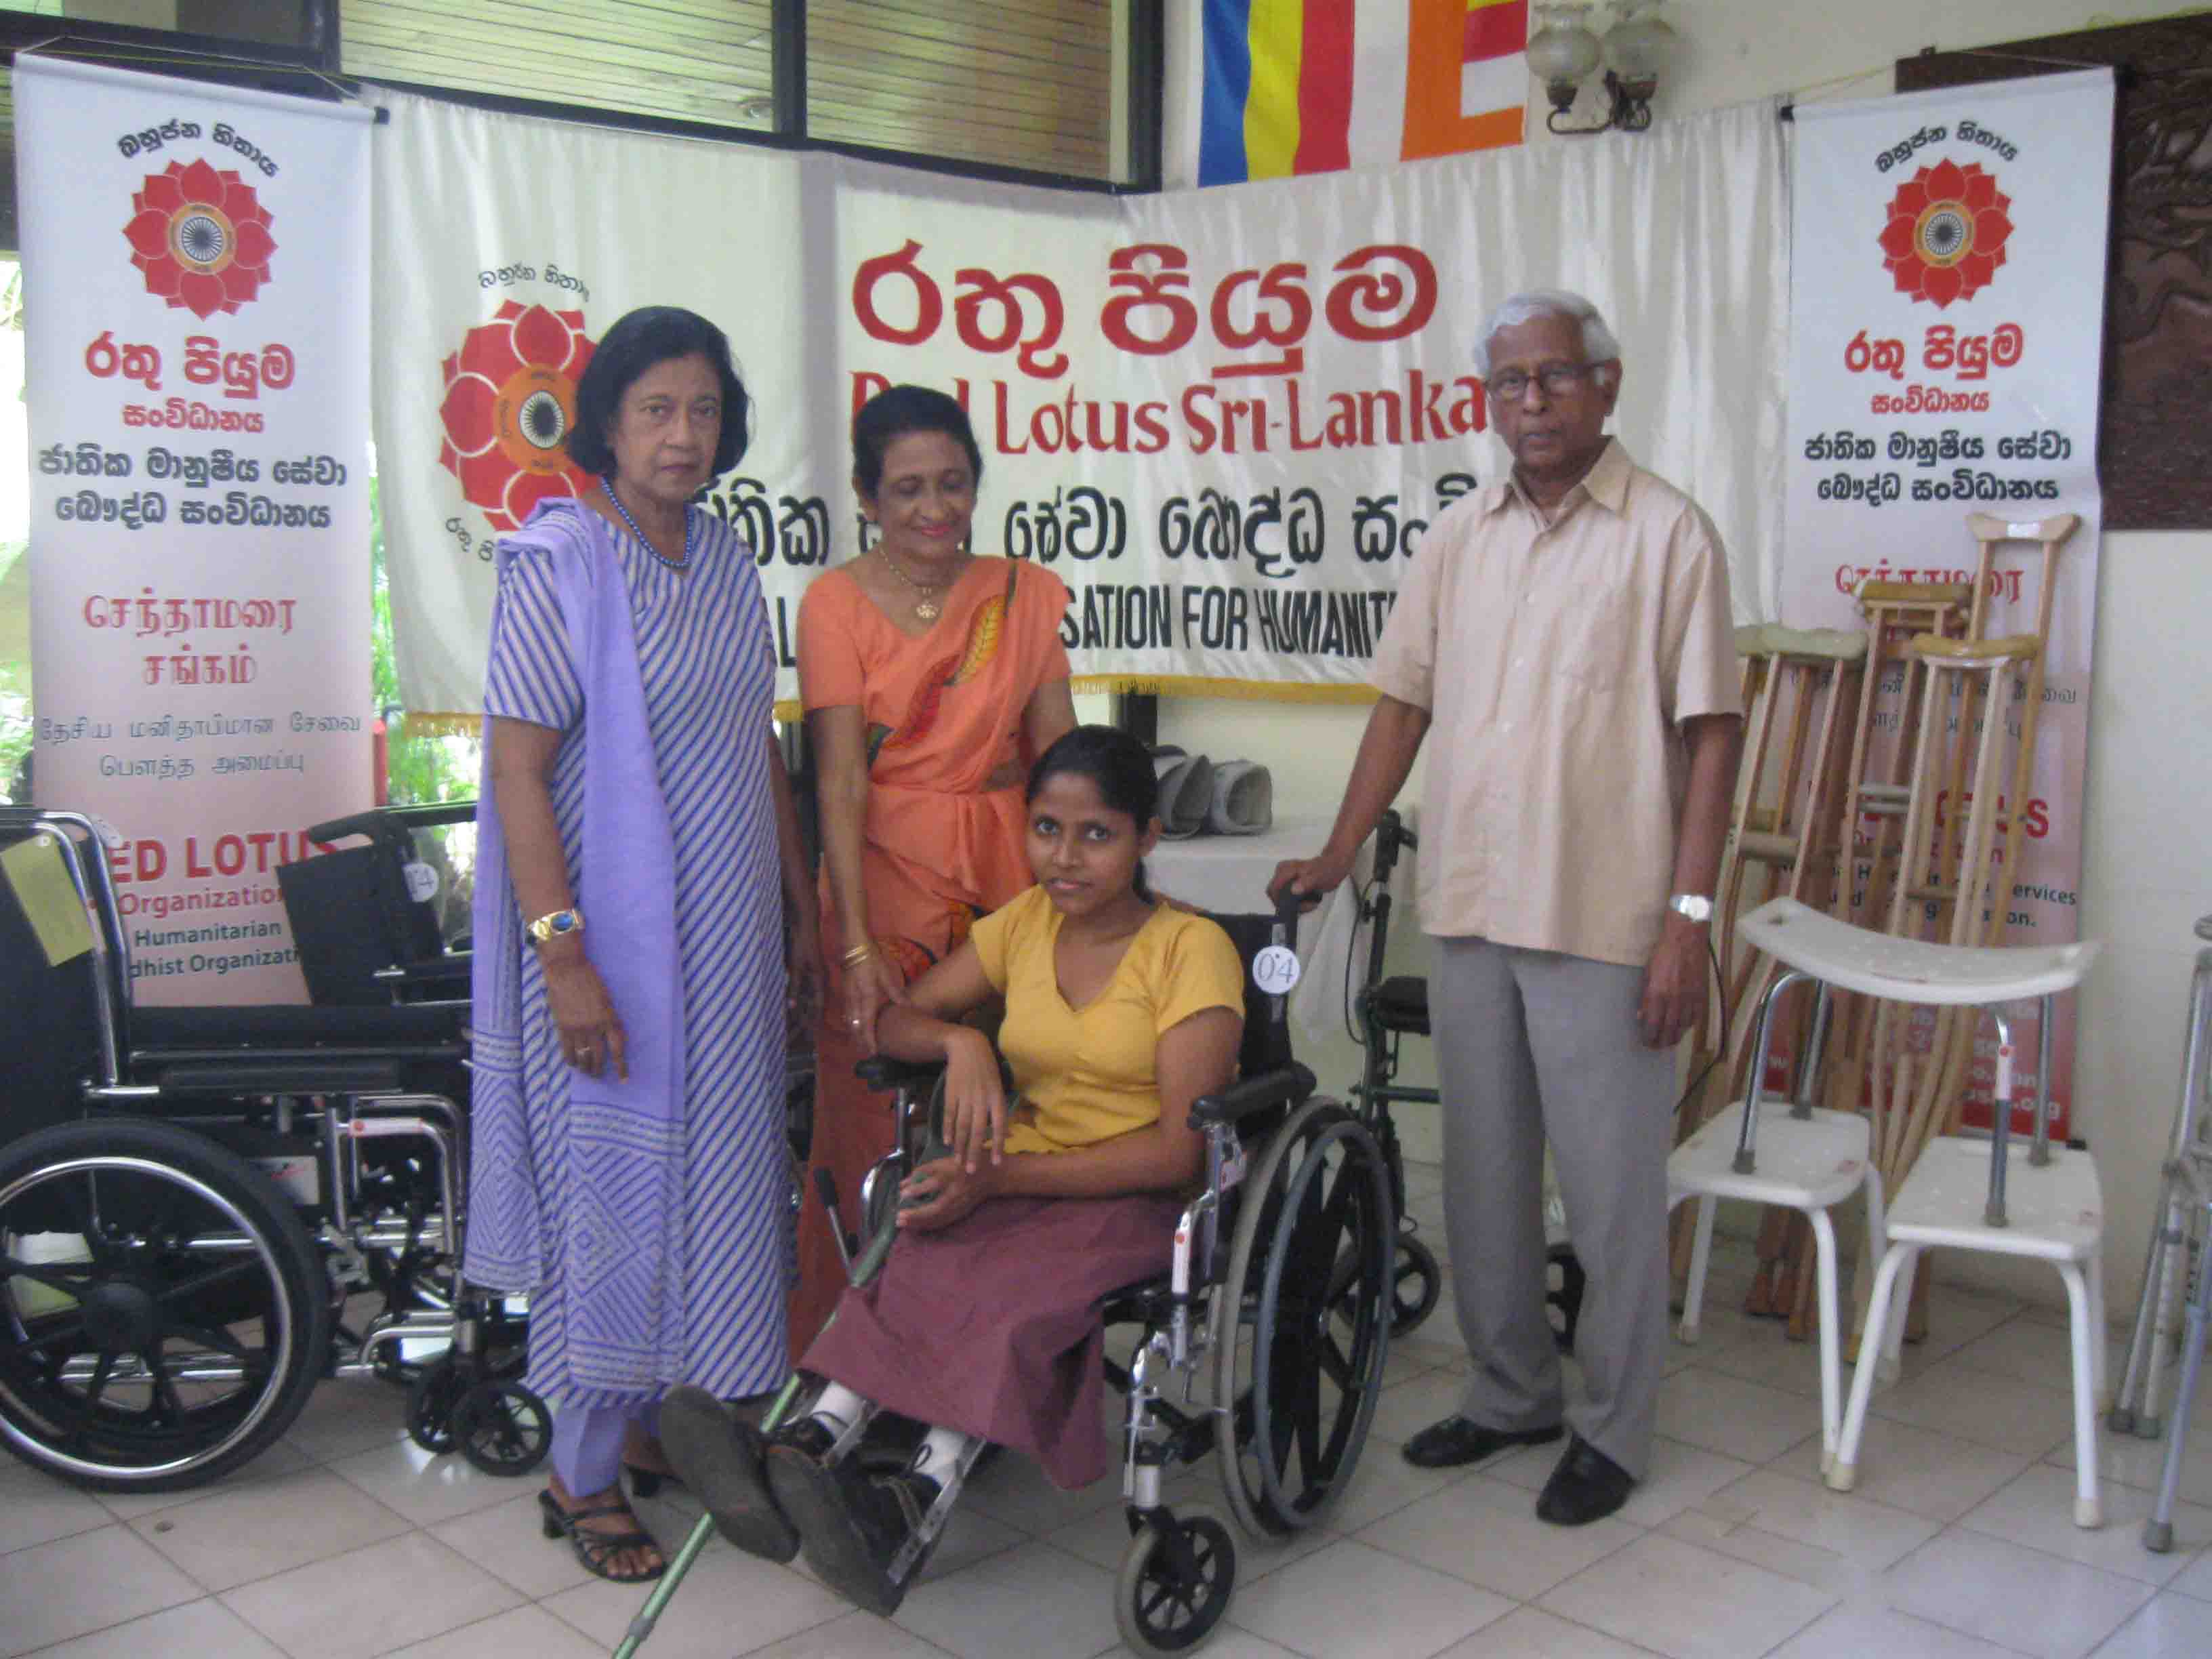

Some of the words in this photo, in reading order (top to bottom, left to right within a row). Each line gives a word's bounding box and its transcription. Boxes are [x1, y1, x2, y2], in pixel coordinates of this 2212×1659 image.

[851, 239, 1069, 380] රතු
[1099, 243, 1438, 379] පියුම
[86, 330, 162, 391] රතු
[184, 335, 294, 400] පියුම
[1844, 330, 1905, 381] රතු
[1923, 322, 2024, 381] පියුම
[122, 396, 264, 434] සංවිධානය
[991, 377, 1170, 455] Lotus
[1870, 384, 1990, 414] සංවිධානය
[39, 442, 133, 478] ජාතික
[272, 455, 348, 487] සේවා
[1804, 431, 1877, 461] ජාතික
[1997, 430, 2072, 460] සේවා
[1911, 468, 2060, 501] සංවිධානය
[180, 491, 331, 528] සංවිධානය
[1004, 485, 1126, 562] සේවා
[85, 586, 297, 637] செந்தாமரை
[1059, 583, 1172, 649] SATION
[1183, 585, 1248, 650] FOR
[144, 643, 257, 685] சங்கம்
[107, 840, 167, 883] ED
[185, 830, 337, 879] LOTU
[2012, 882, 2076, 906] ervices
[136, 920, 282, 947] Humanitarian
[129, 956, 184, 978] dhist
[190, 946, 300, 981] Organizati
